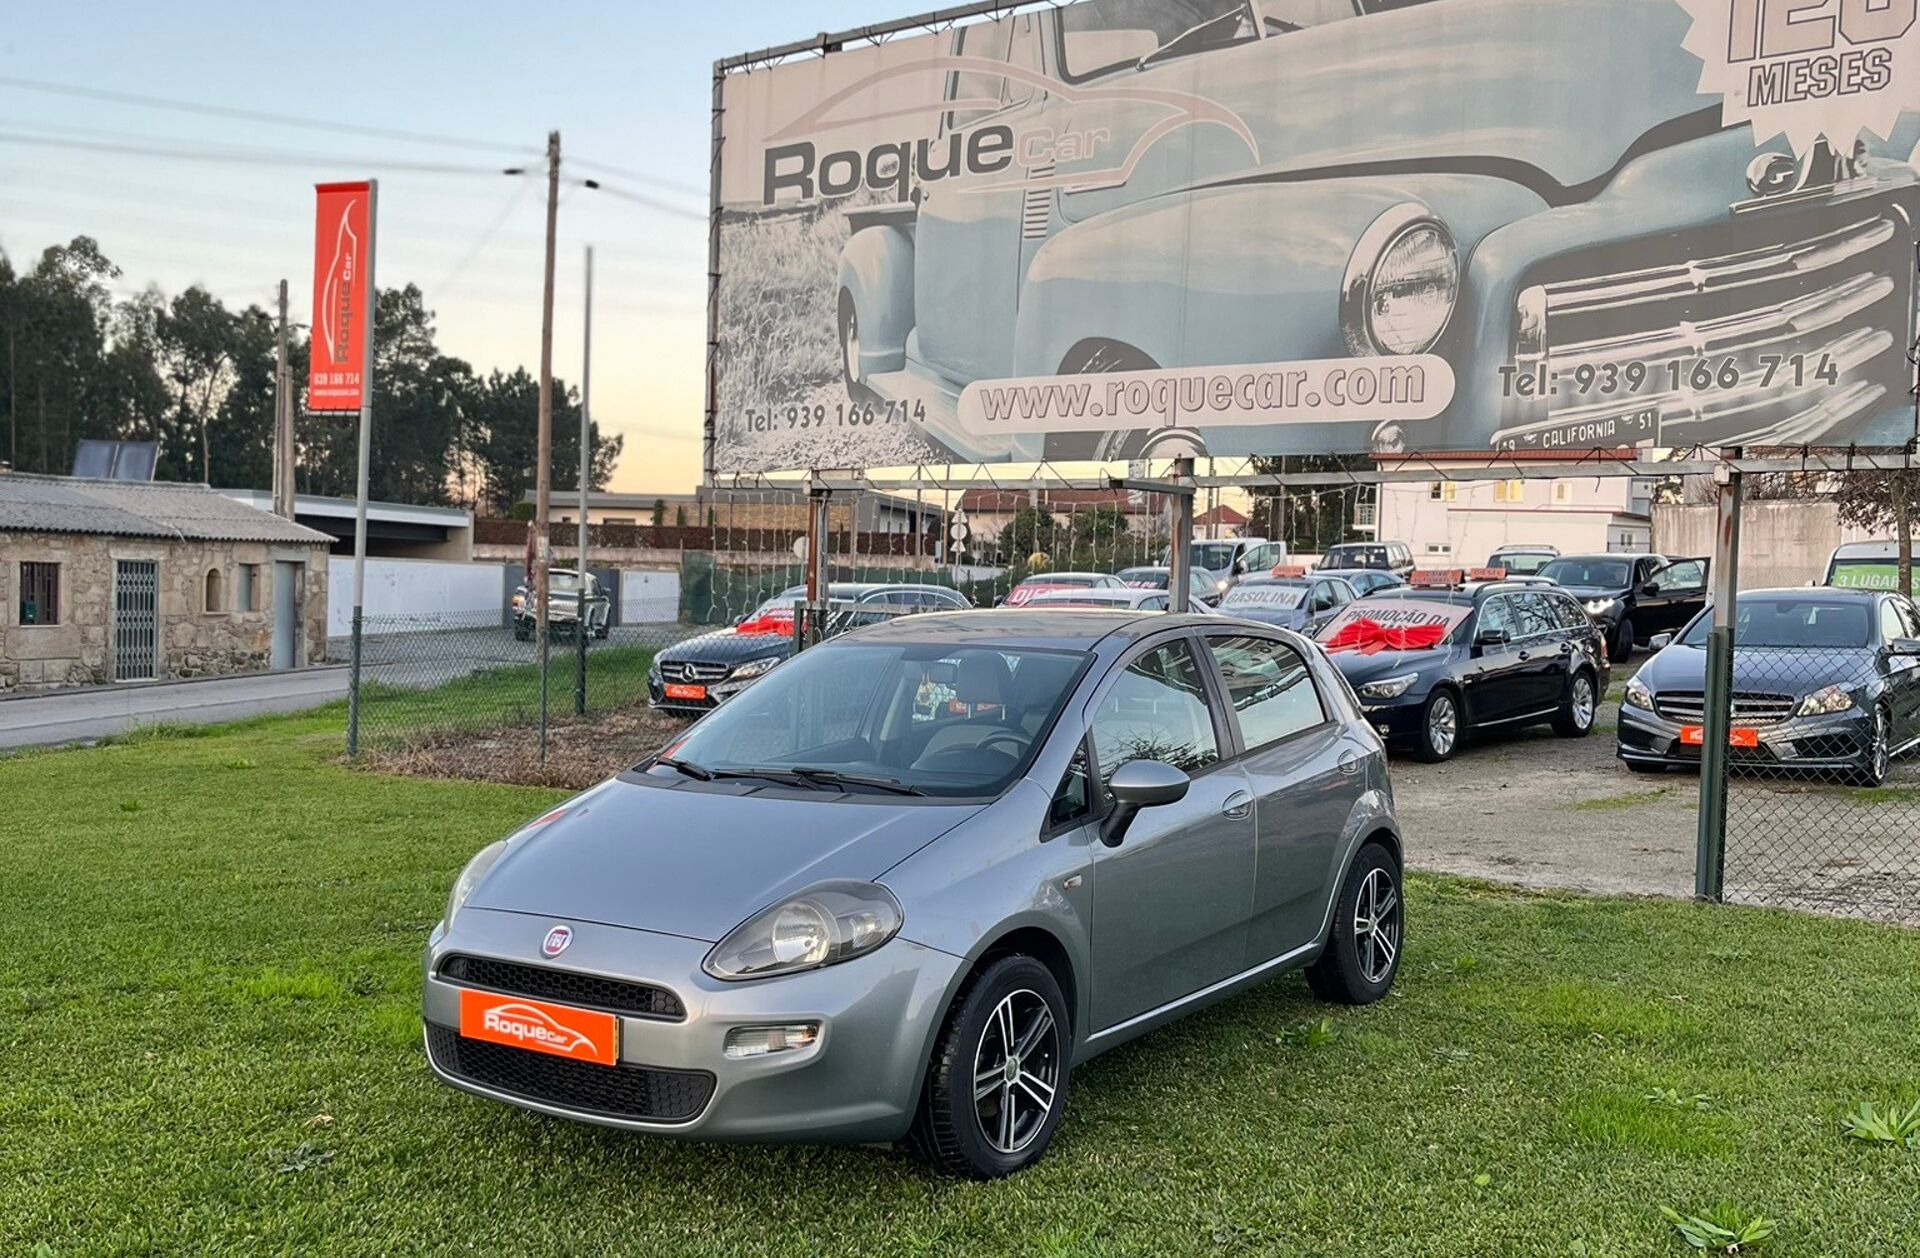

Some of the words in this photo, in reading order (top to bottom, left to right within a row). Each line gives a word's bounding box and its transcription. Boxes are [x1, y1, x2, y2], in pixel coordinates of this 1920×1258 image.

[1747, 47, 1892, 107] MESES
[1498, 363, 1559, 397] Tel:
[1574, 361, 1647, 395] 939
[1666, 357, 1740, 391] 166
[1759, 352, 1839, 388] 714
[980, 364, 1425, 427] www.roquecar.com
[745, 408, 778, 432] Tel:
[786, 404, 826, 429] 939
[835, 403, 875, 427] 166
[884, 399, 926, 424] 714
[1542, 419, 1615, 448] CALIFORNIA
[1639, 412, 1652, 430] 51
[1227, 591, 1298, 606] GASOLINA
[1838, 575, 1848, 587] 3
[1851, 574, 1920, 589] LUGARS
[1343, 608, 1427, 624] PROMOÇÃO
